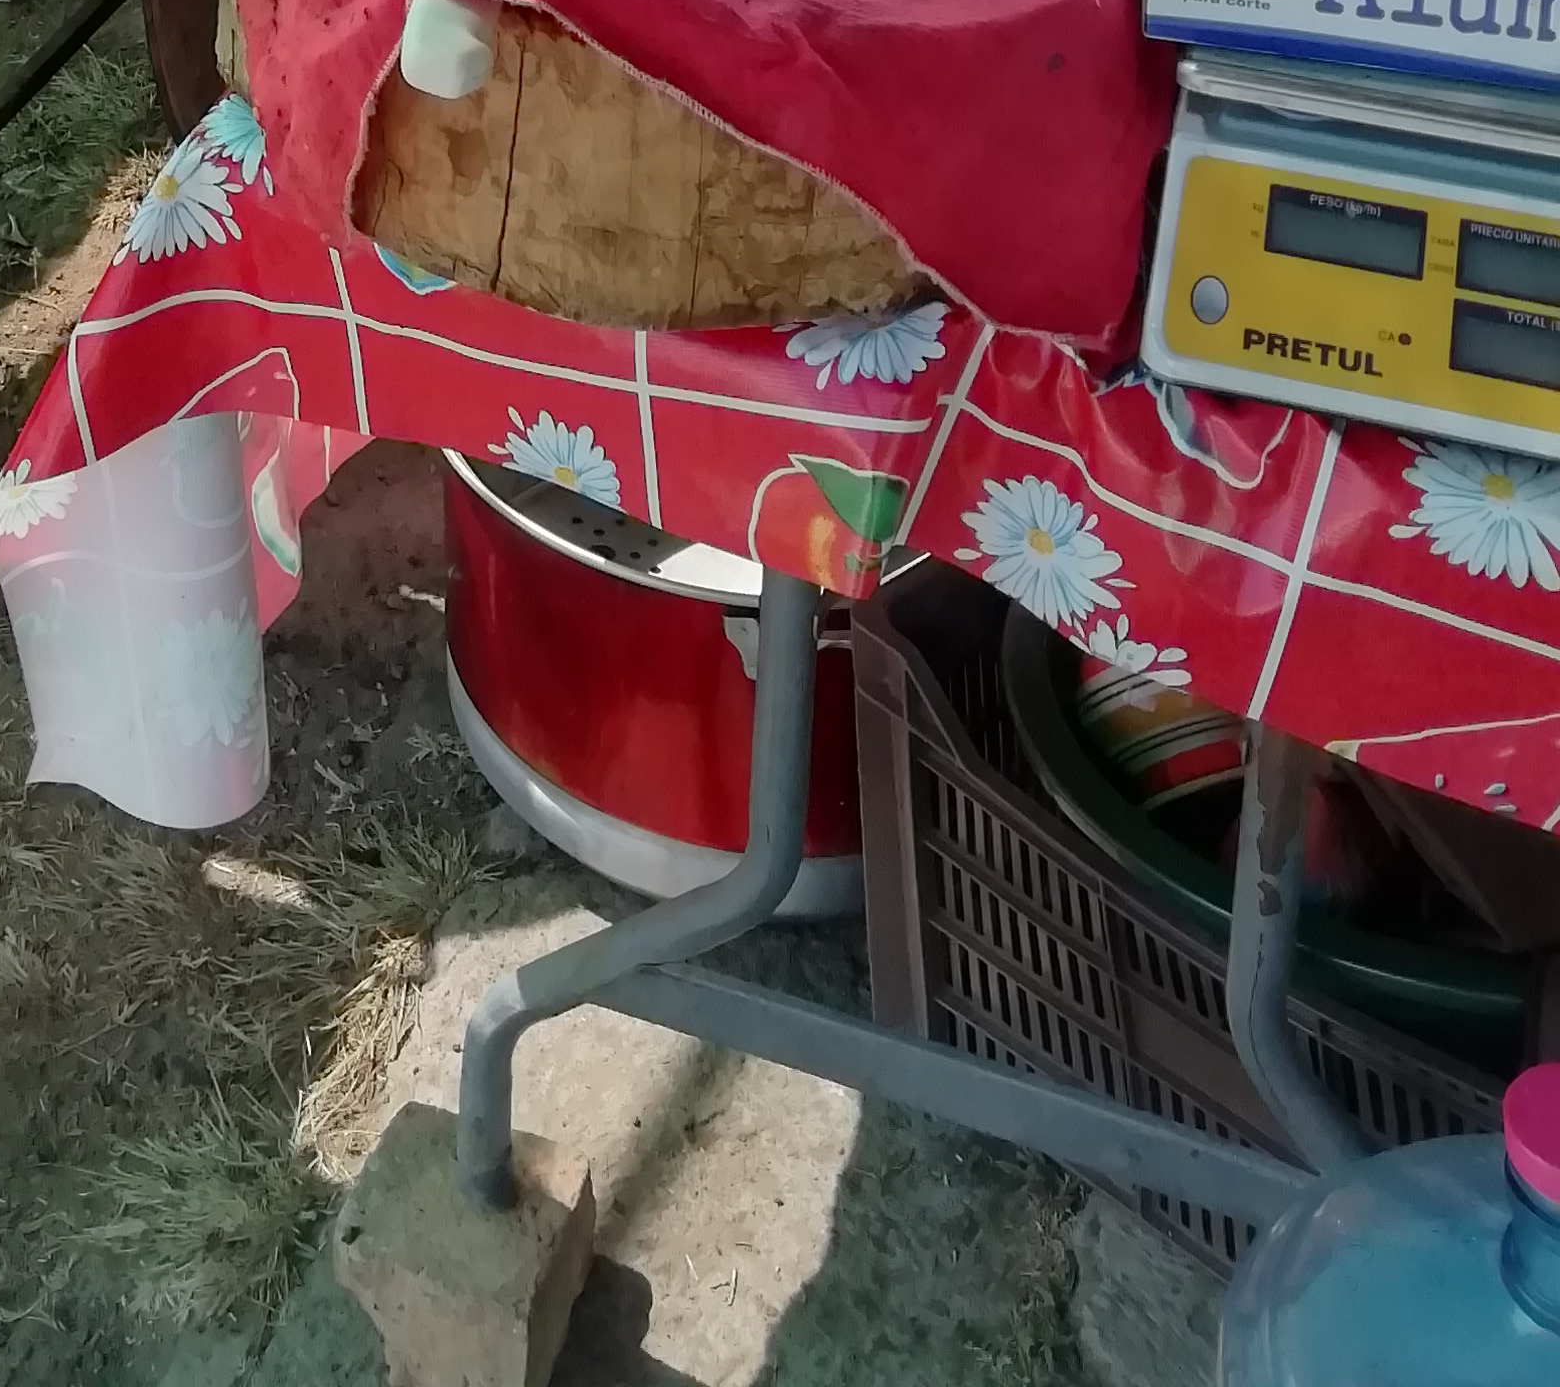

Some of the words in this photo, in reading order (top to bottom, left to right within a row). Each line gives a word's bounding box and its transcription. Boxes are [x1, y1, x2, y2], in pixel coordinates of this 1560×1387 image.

[1309, 193, 1344, 209] PESO
[1470, 223, 1514, 241] PRECIO
[1507, 310, 1546, 329] TOTAL
[1242, 327, 1384, 379] PRETUL
